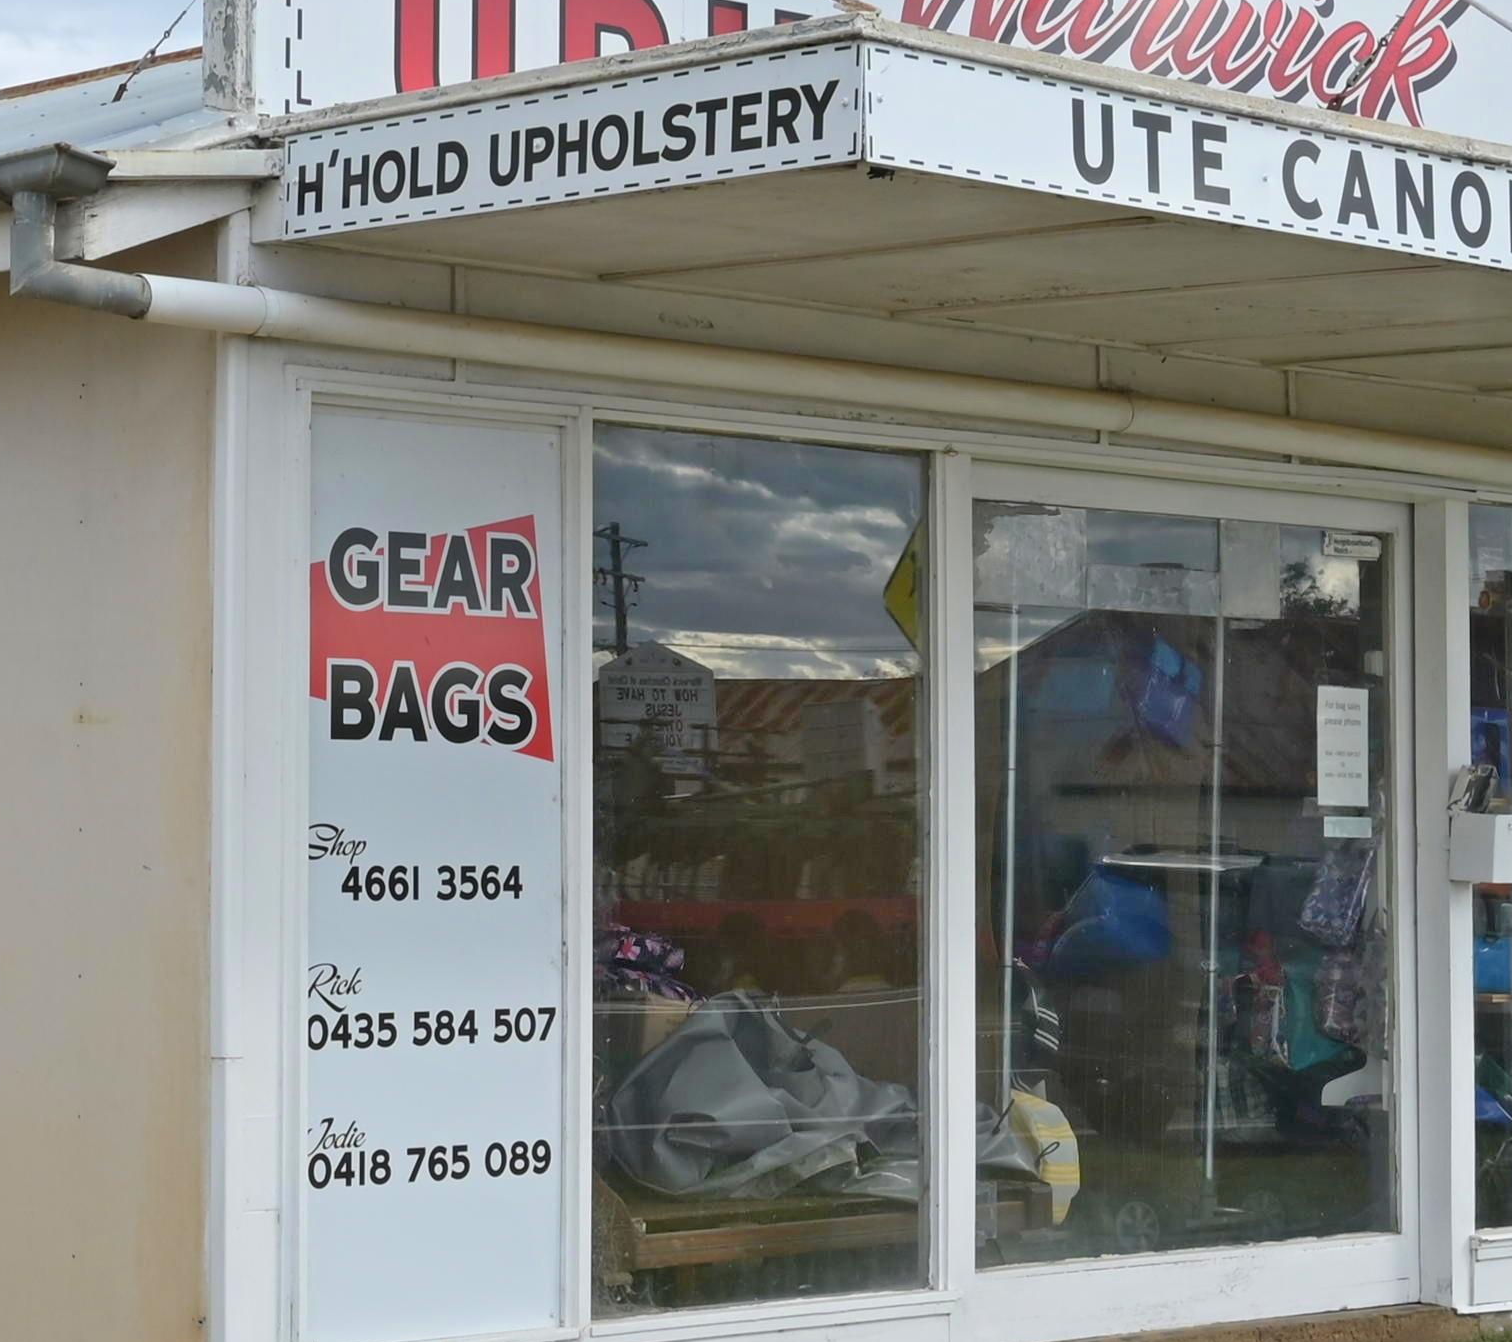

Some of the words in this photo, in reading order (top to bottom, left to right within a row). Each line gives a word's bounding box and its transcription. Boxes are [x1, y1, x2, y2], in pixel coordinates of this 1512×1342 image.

[489, 79, 840, 187] UPHOLSTERY
[1072, 98, 1231, 206] UTE
[328, 526, 533, 613] GEAR
[329, 662, 535, 746] BAGS
[308, 823, 367, 864] Shop
[341, 865, 420, 901] 4661
[436, 865, 523, 900] 3564
[308, 963, 362, 1013] Rick
[308, 1012, 398, 1051] 0435
[412, 1010, 478, 1046] 584
[493, 1007, 556, 1043] 507
[308, 1117, 366, 1156] Jodie
[308, 1148, 391, 1189] 0418
[407, 1145, 470, 1183] 765
[484, 1139, 552, 1177] 089
